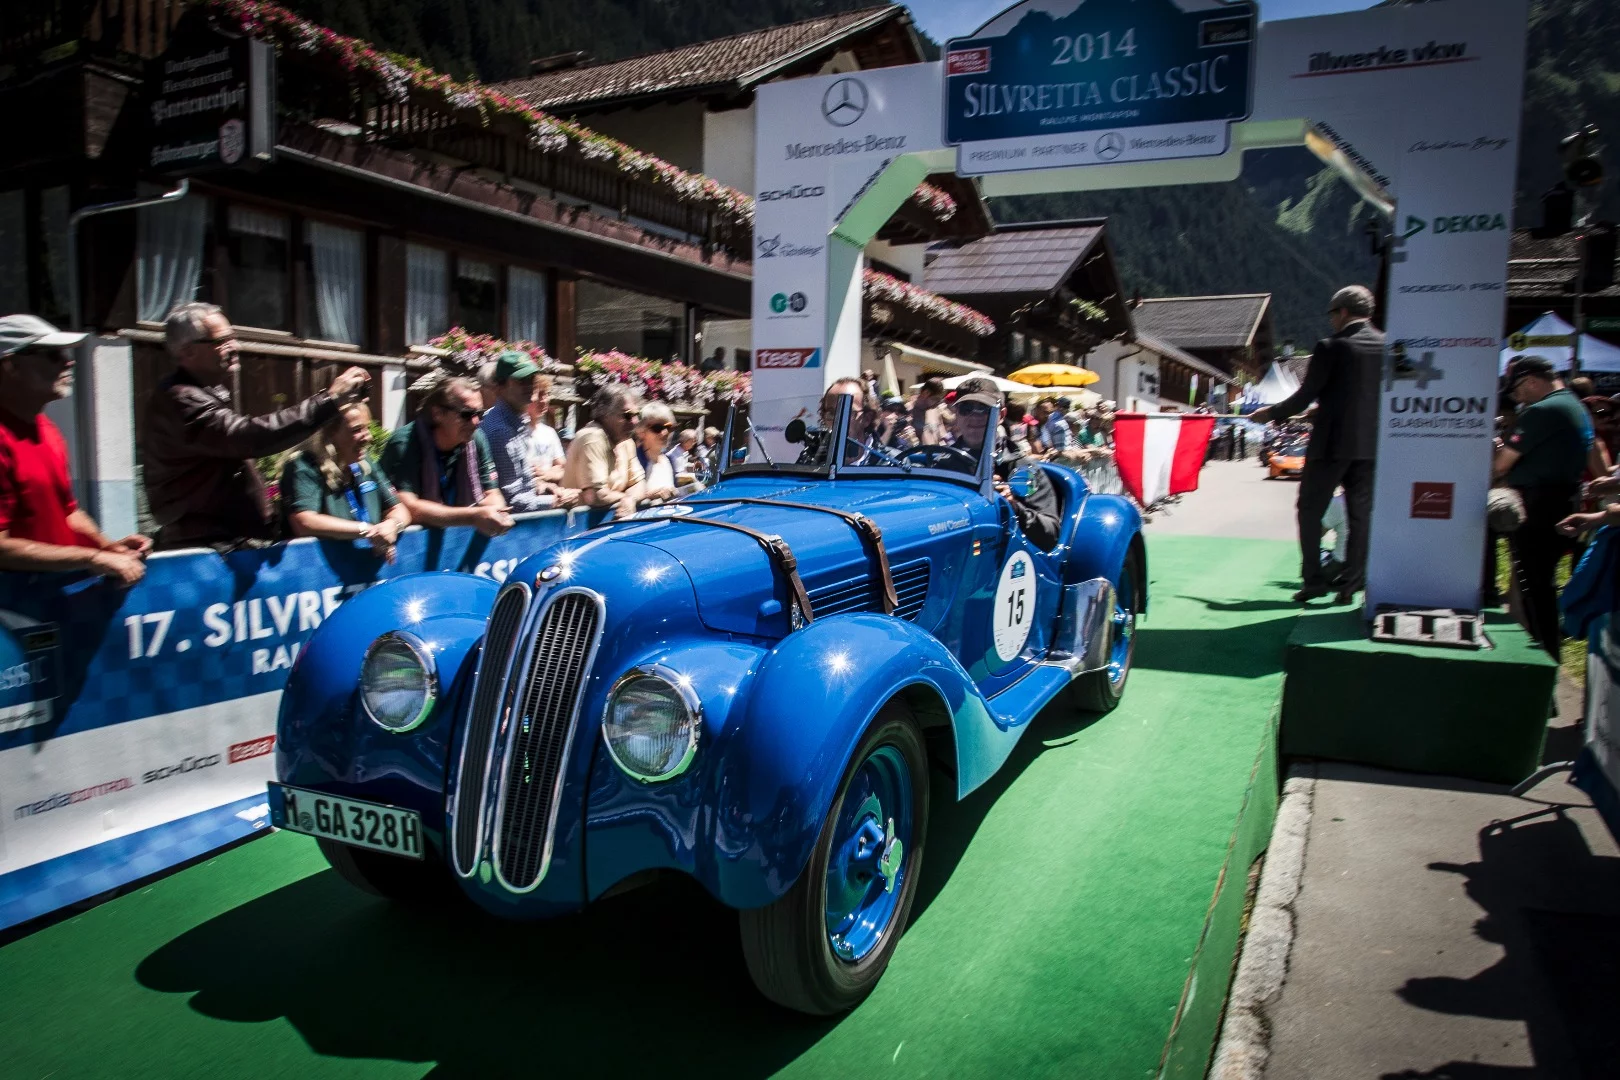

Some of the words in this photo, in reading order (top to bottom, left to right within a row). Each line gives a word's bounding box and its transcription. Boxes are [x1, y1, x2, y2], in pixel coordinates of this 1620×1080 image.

[1051, 28, 1137, 66] 2014
[1309, 45, 1408, 72] illwerke
[1412, 40, 1467, 61] vkw
[964, 81, 1103, 118] SILVRETTA
[1111, 55, 1229, 103] CLASSIC
[785, 135, 907, 160] Mercedes-Benz
[969, 147, 1027, 162] PREMIUM
[1031, 143, 1089, 157] PARTNER
[1129, 133, 1218, 150] Mercedes-Benz
[1432, 213, 1507, 234] DEKRA
[757, 350, 804, 368] tesa
[1391, 397, 1489, 414] UNION
[928, 521, 947, 535] BMW
[1008, 589, 1025, 627] 15
[124, 610, 192, 660] 17.
[230, 739, 271, 761] tesa
[283, 793, 298, 827] M
